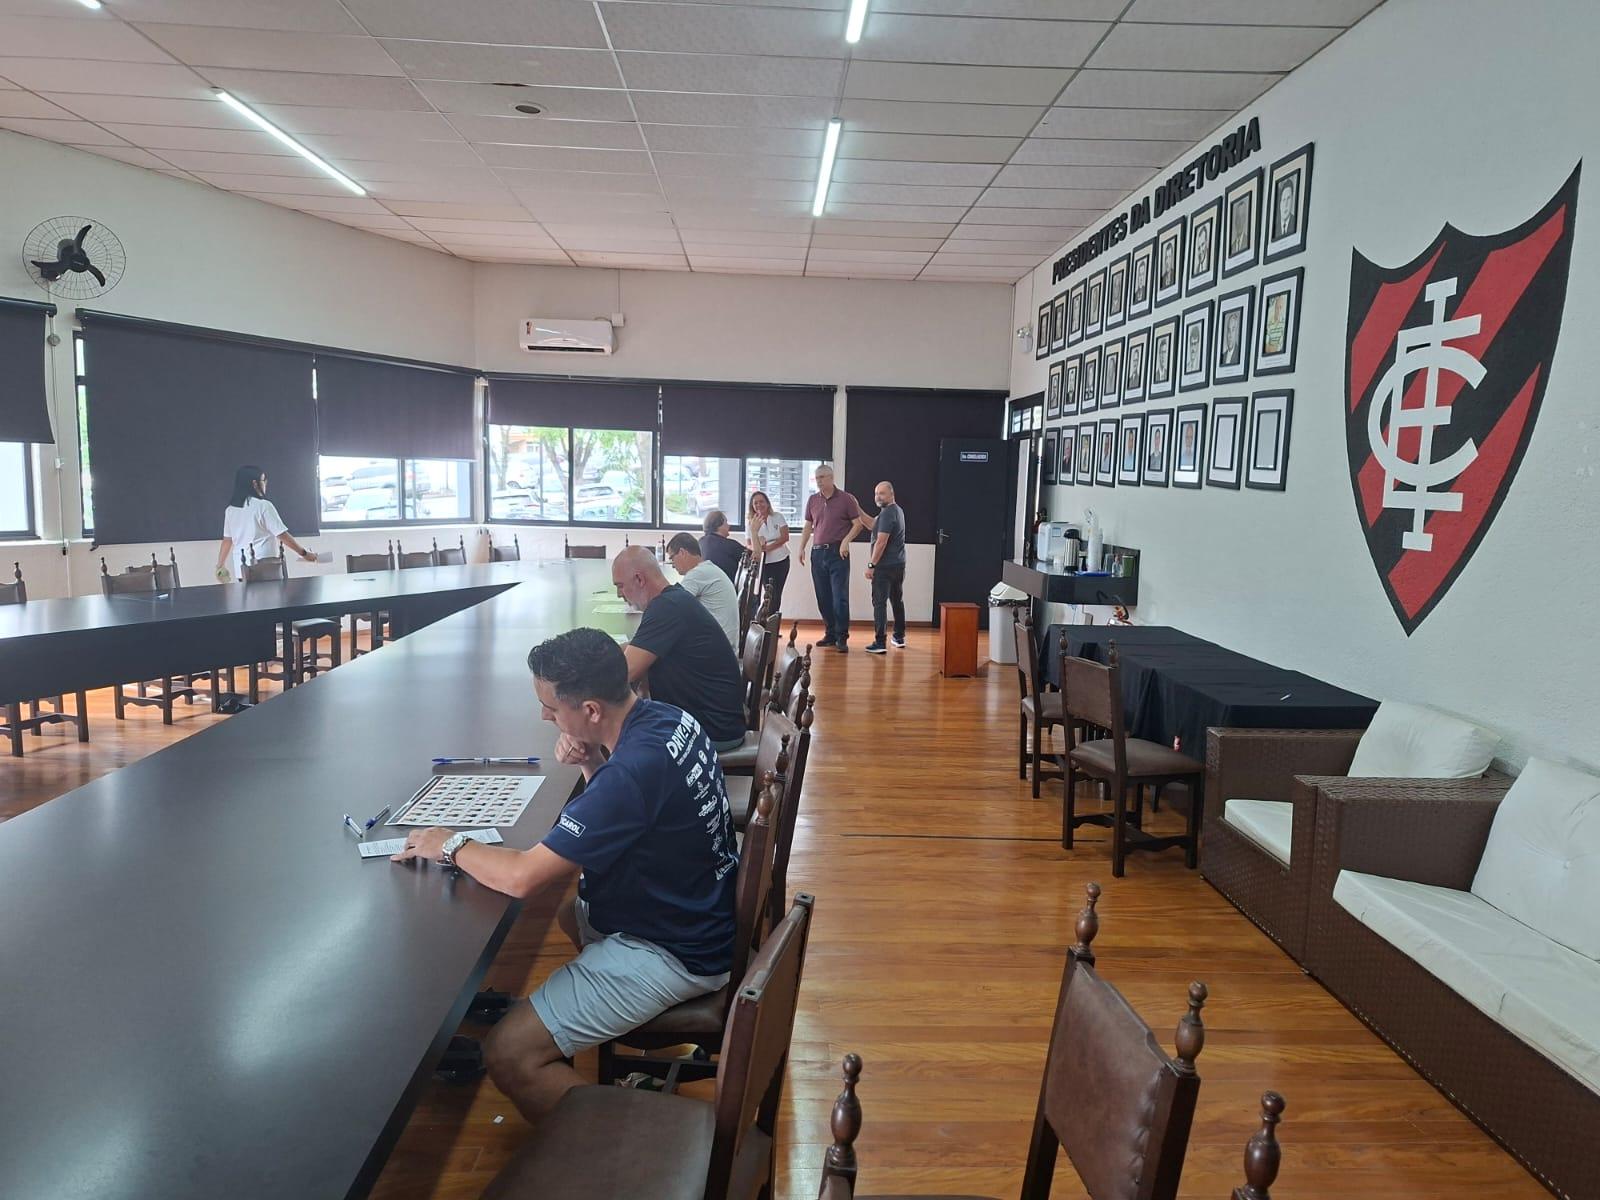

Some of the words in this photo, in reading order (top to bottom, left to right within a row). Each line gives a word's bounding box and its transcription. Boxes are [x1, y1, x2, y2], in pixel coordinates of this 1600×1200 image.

[1052, 212, 1128, 285] PRESIDENTES
[1130, 196, 1150, 234] DA
[1154, 116, 1262, 219] DIRETORIA
